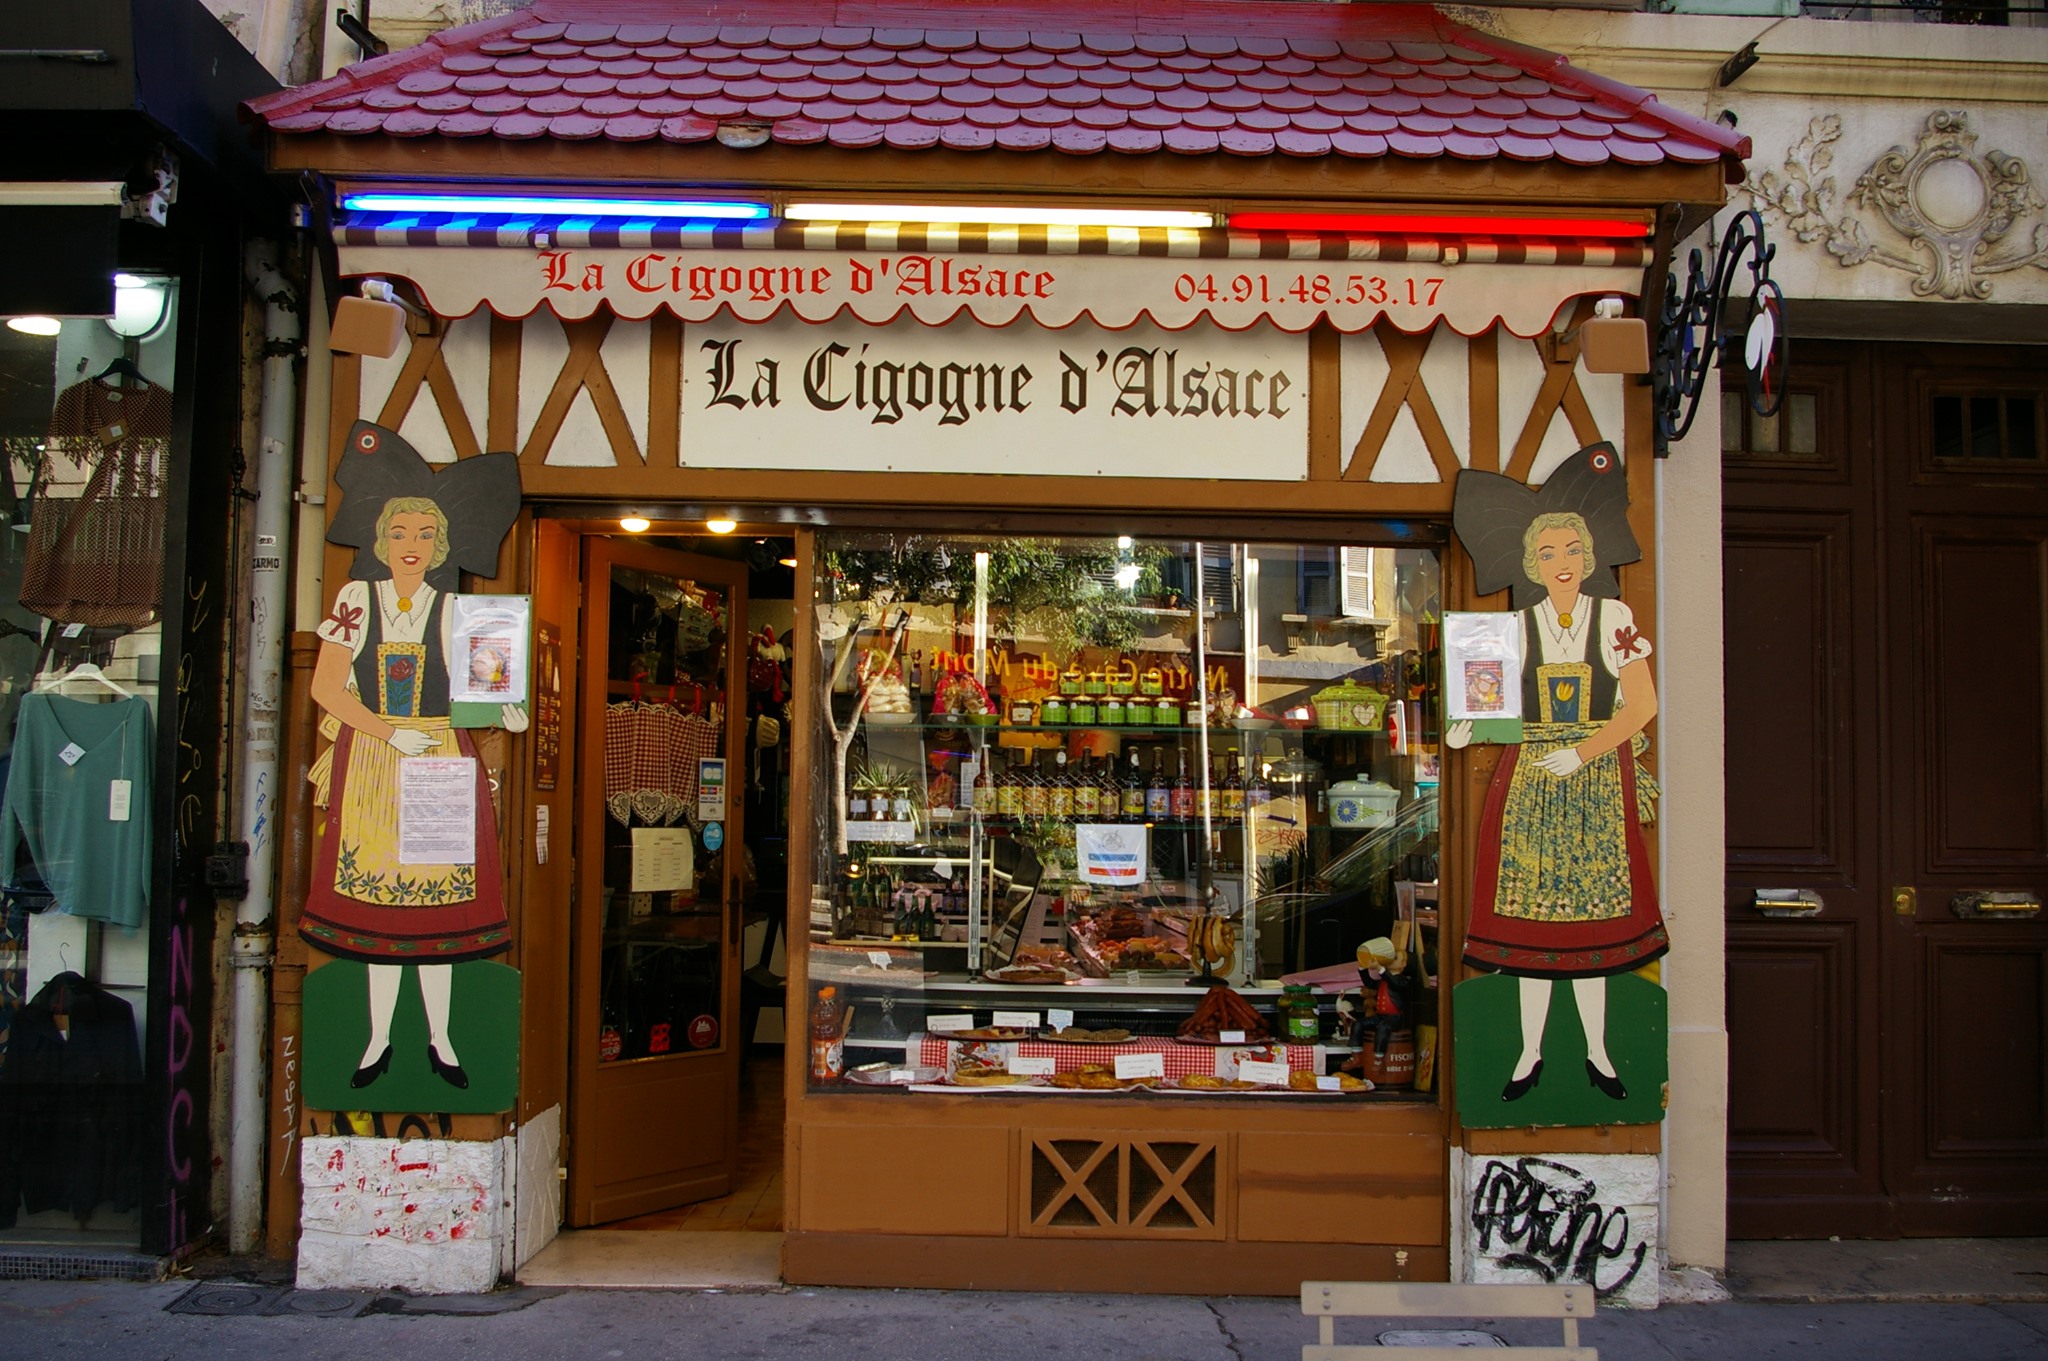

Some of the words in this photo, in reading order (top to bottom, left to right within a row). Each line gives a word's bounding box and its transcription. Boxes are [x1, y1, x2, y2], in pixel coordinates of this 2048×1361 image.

[538, 251, 605, 294] La
[625, 252, 832, 303] Cigogne
[848, 254, 1056, 302] d'Alsace
[1174, 273, 1446, 308] 04.91.48.53.17
[700, 339, 781, 411] La
[803, 341, 1033, 426] Cigogne
[1059, 346, 1293, 419] d'Alsace
